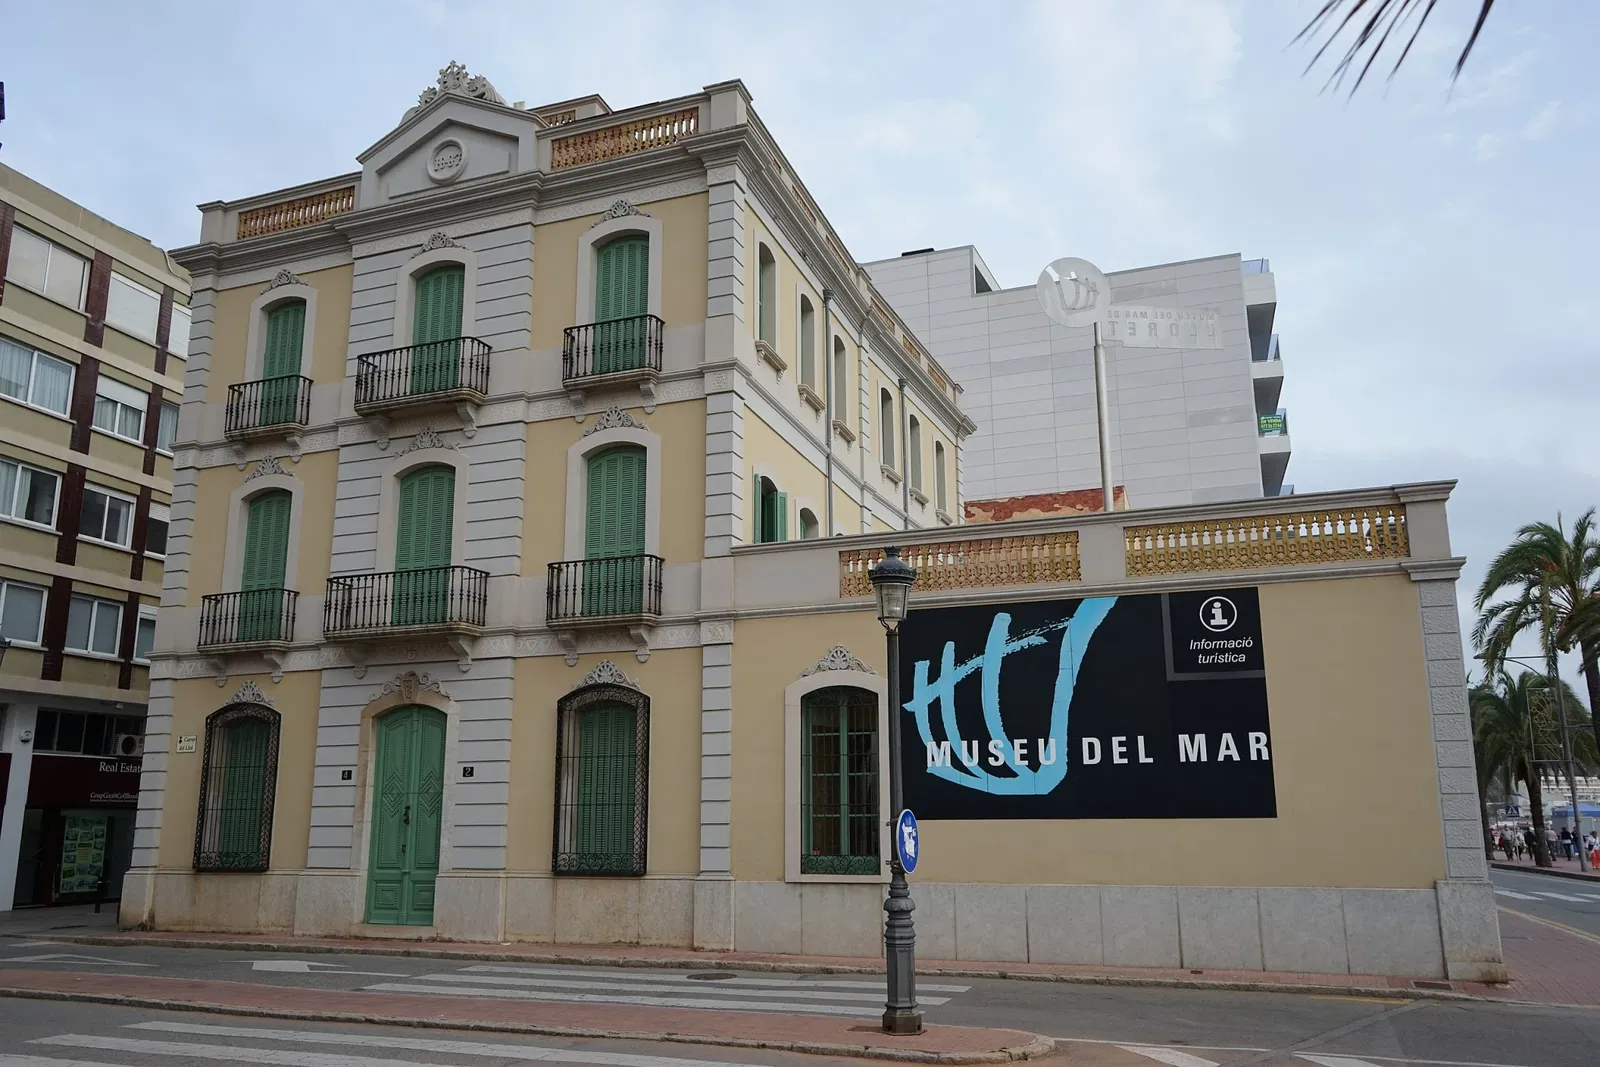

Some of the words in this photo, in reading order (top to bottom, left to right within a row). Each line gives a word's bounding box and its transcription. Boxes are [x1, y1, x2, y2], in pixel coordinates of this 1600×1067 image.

[1189, 636, 1253, 651] Informació
[1198, 651, 1246, 665] turística
[926, 738, 1057, 767] MUSEU
[1082, 735, 1153, 764] DEL
[1178, 732, 1270, 763] MAR
[99, 761, 118, 773] Real
[465, 767, 471, 777] 2
